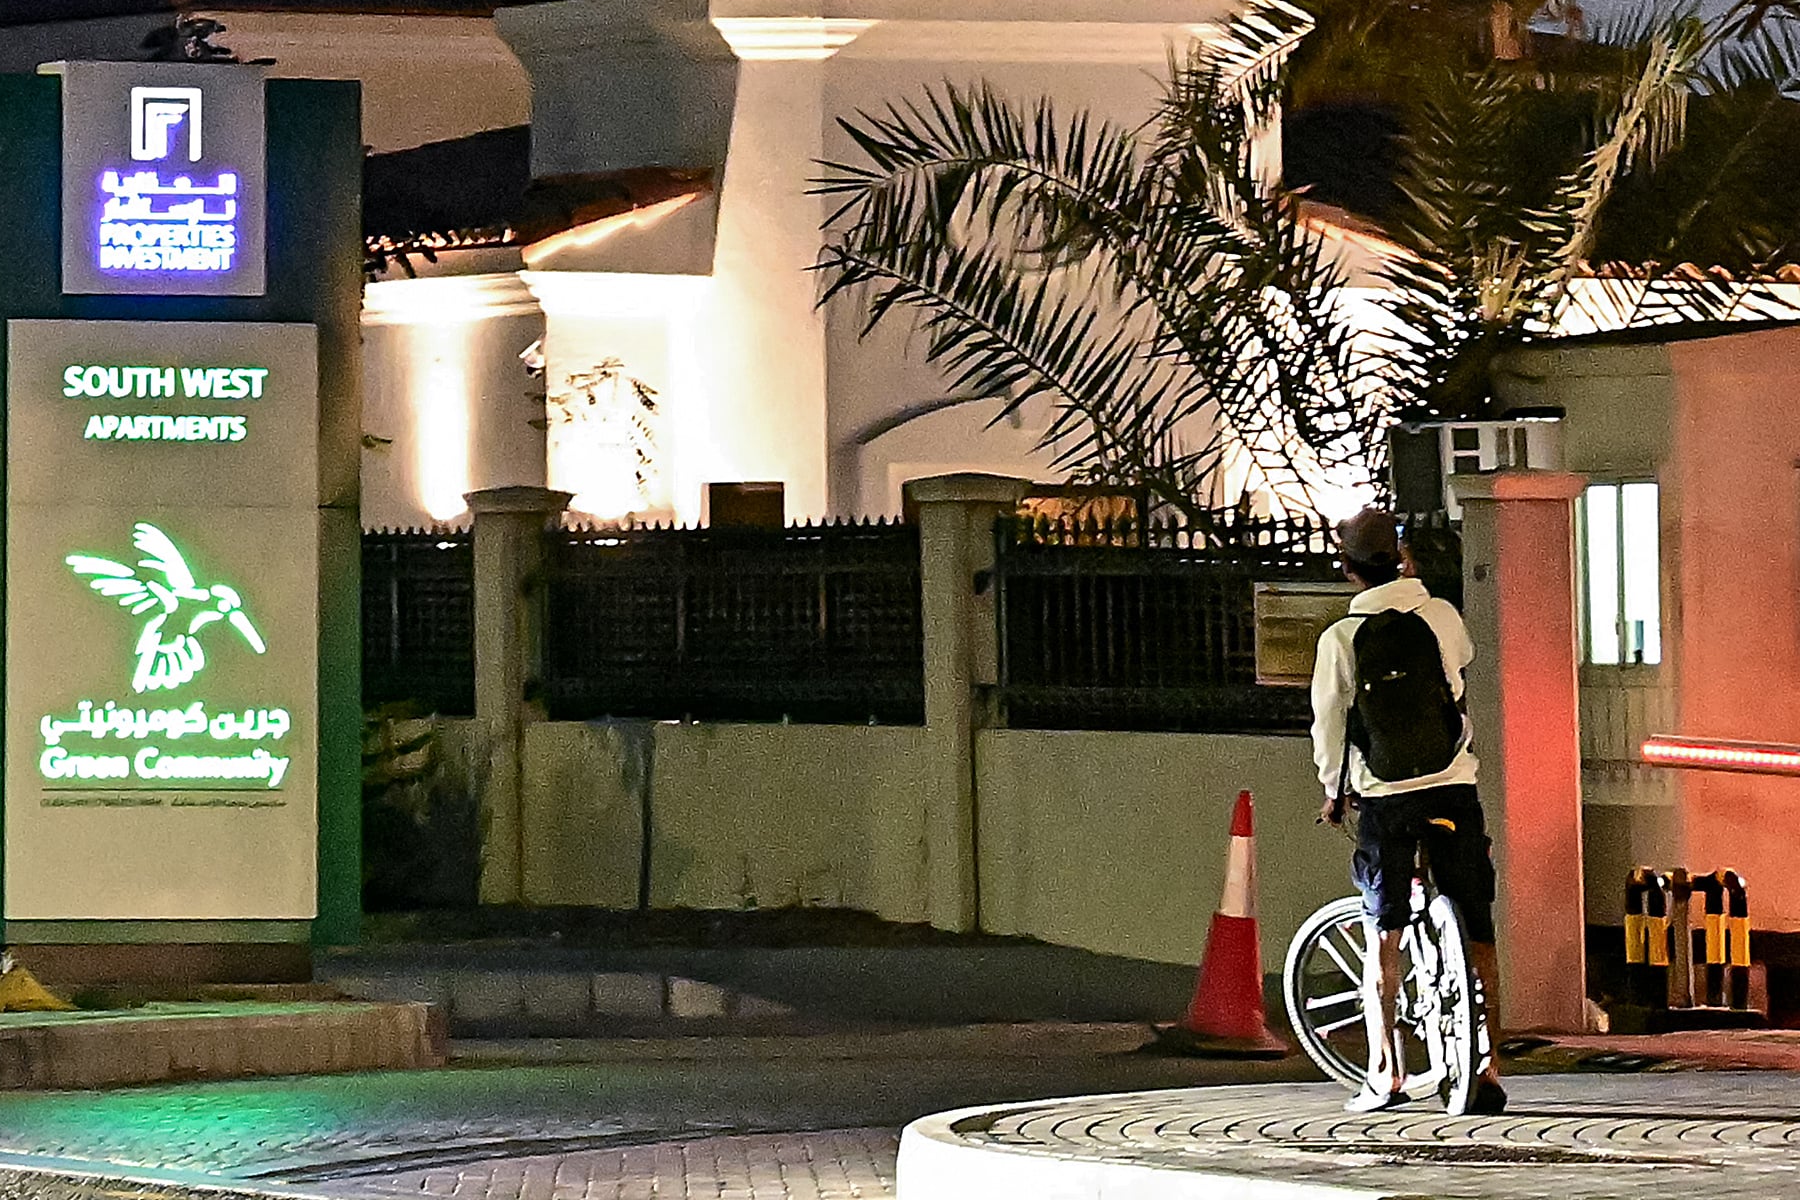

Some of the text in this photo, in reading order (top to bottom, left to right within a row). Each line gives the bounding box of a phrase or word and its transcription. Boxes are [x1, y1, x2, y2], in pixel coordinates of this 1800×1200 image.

[99, 222, 236, 248] PROPERTIES
[99, 246, 235, 270] INVESTMENT
[62, 365, 269, 399] SOUTH WEST
[83, 415, 247, 442] APARTMENTS
[39, 746, 291, 788] Green Community
